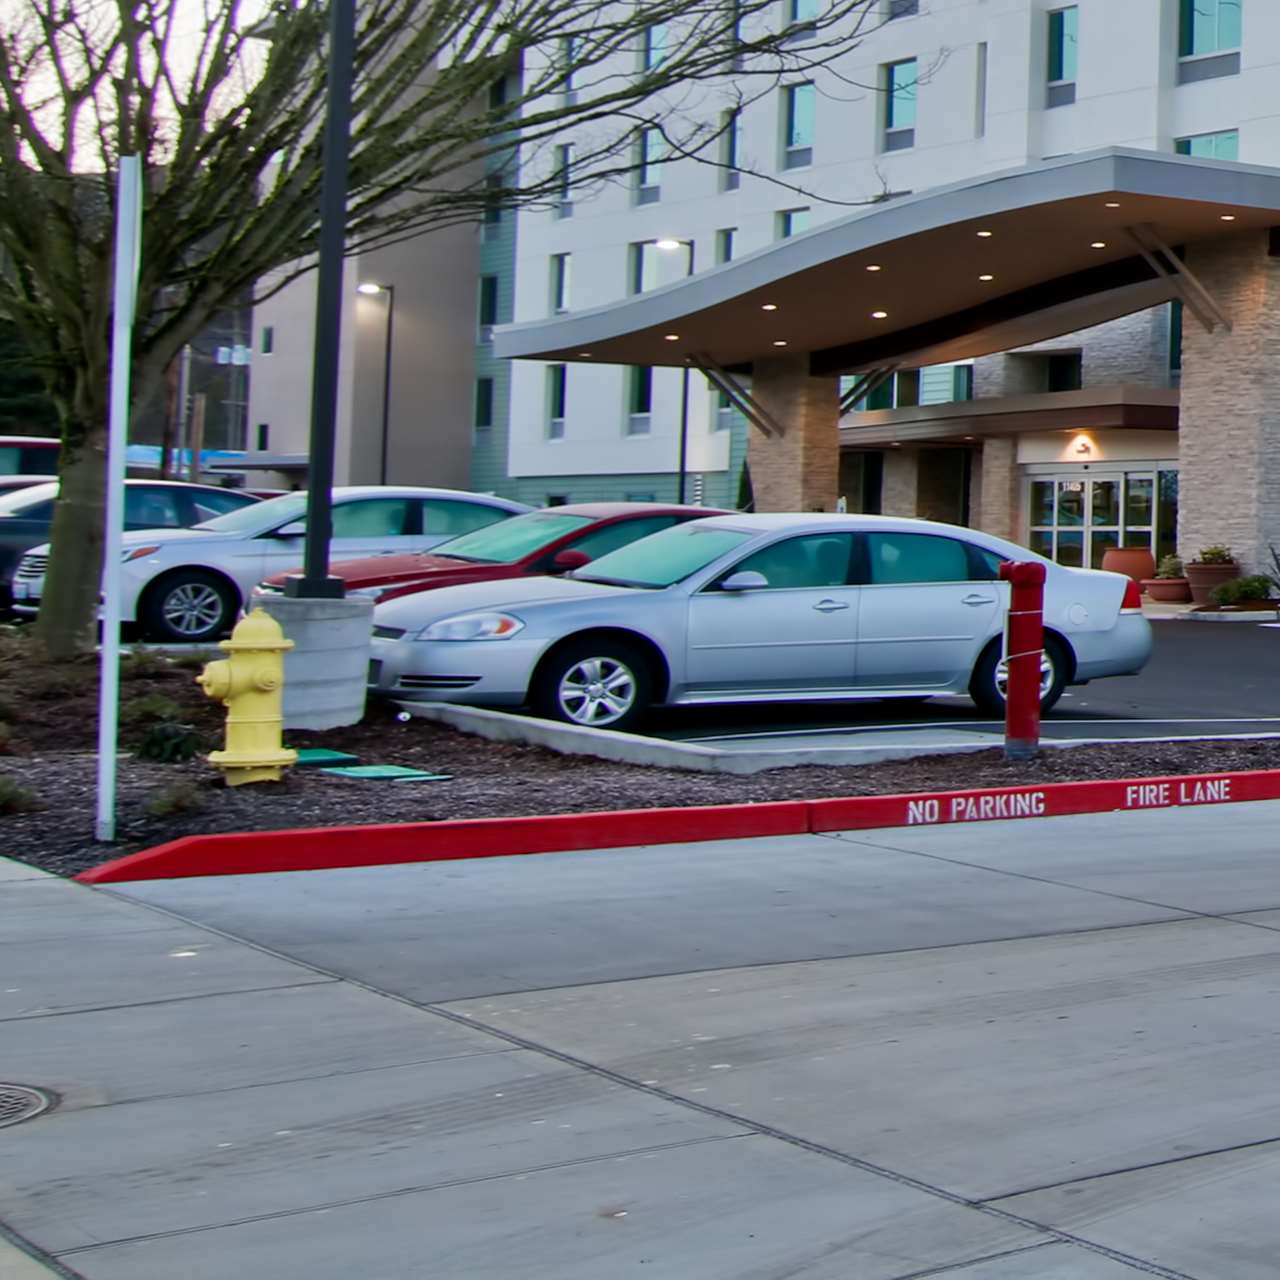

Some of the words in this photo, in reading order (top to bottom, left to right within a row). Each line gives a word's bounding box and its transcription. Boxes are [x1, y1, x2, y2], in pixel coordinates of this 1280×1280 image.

[907, 800, 939, 824] NO
[951, 792, 1045, 821] PARKING
[1126, 784, 1170, 806] FIRE
[1180, 779, 1232, 801] LANE
